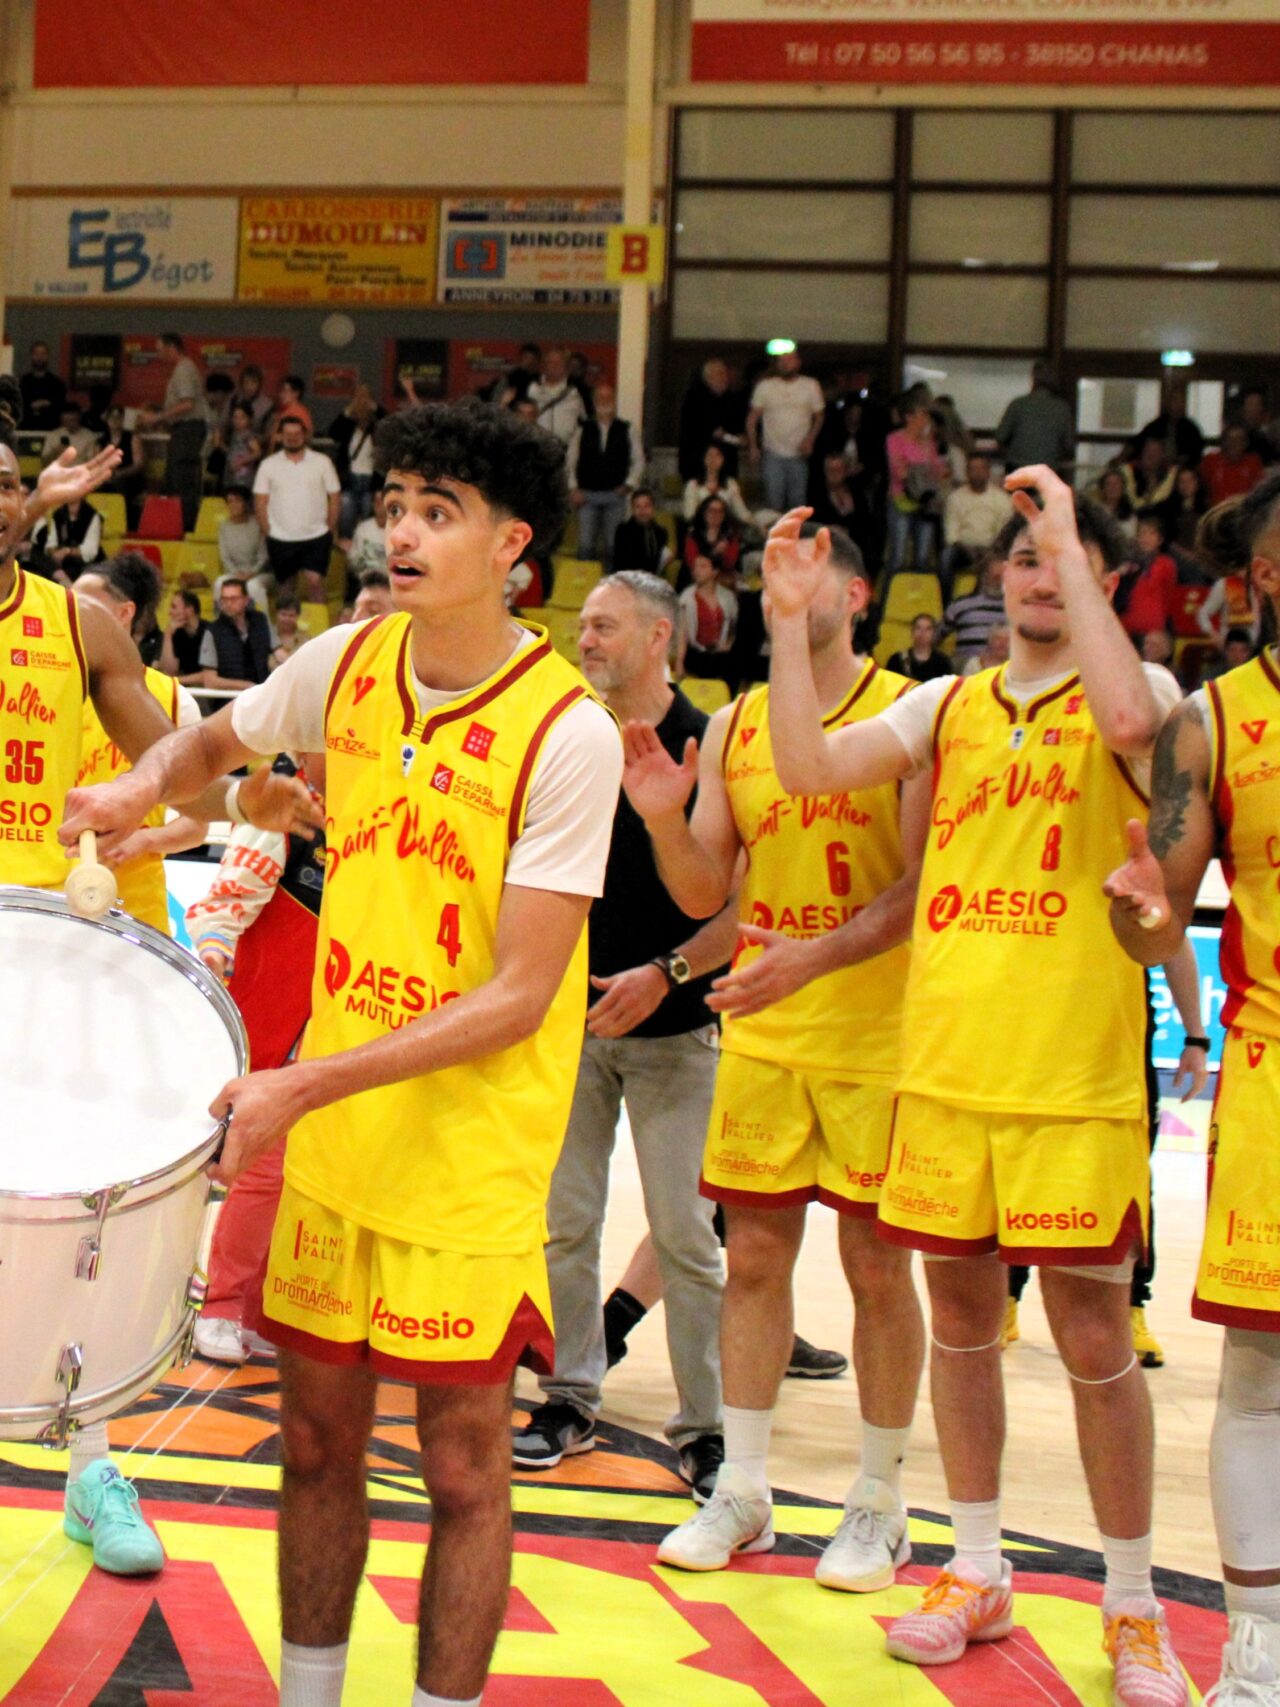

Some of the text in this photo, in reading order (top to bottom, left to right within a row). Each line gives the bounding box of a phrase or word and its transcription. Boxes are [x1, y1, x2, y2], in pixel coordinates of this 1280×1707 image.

[833, 42, 866, 64] 07
[250, 221, 427, 244] DUMOULIN
[510, 231, 605, 247] MINODIE
[620, 233, 648, 273] B
[5, 738, 45, 785] 35
[749, 788, 872, 848] int-Vallier
[1040, 824, 1062, 871] 8
[825, 840, 851, 896] 6
[963, 886, 1068, 919] AÉSIO
[436, 903, 463, 968] 4
[958, 917, 1058, 937] MUTUELLE
[345, 994, 419, 1031] MUTU
[1006, 1205, 1099, 1231] koesio
[302, 1244, 344, 1267] VALLI
[303, 1230, 345, 1249] SAINT
[370, 1296, 476, 1341] koesio
